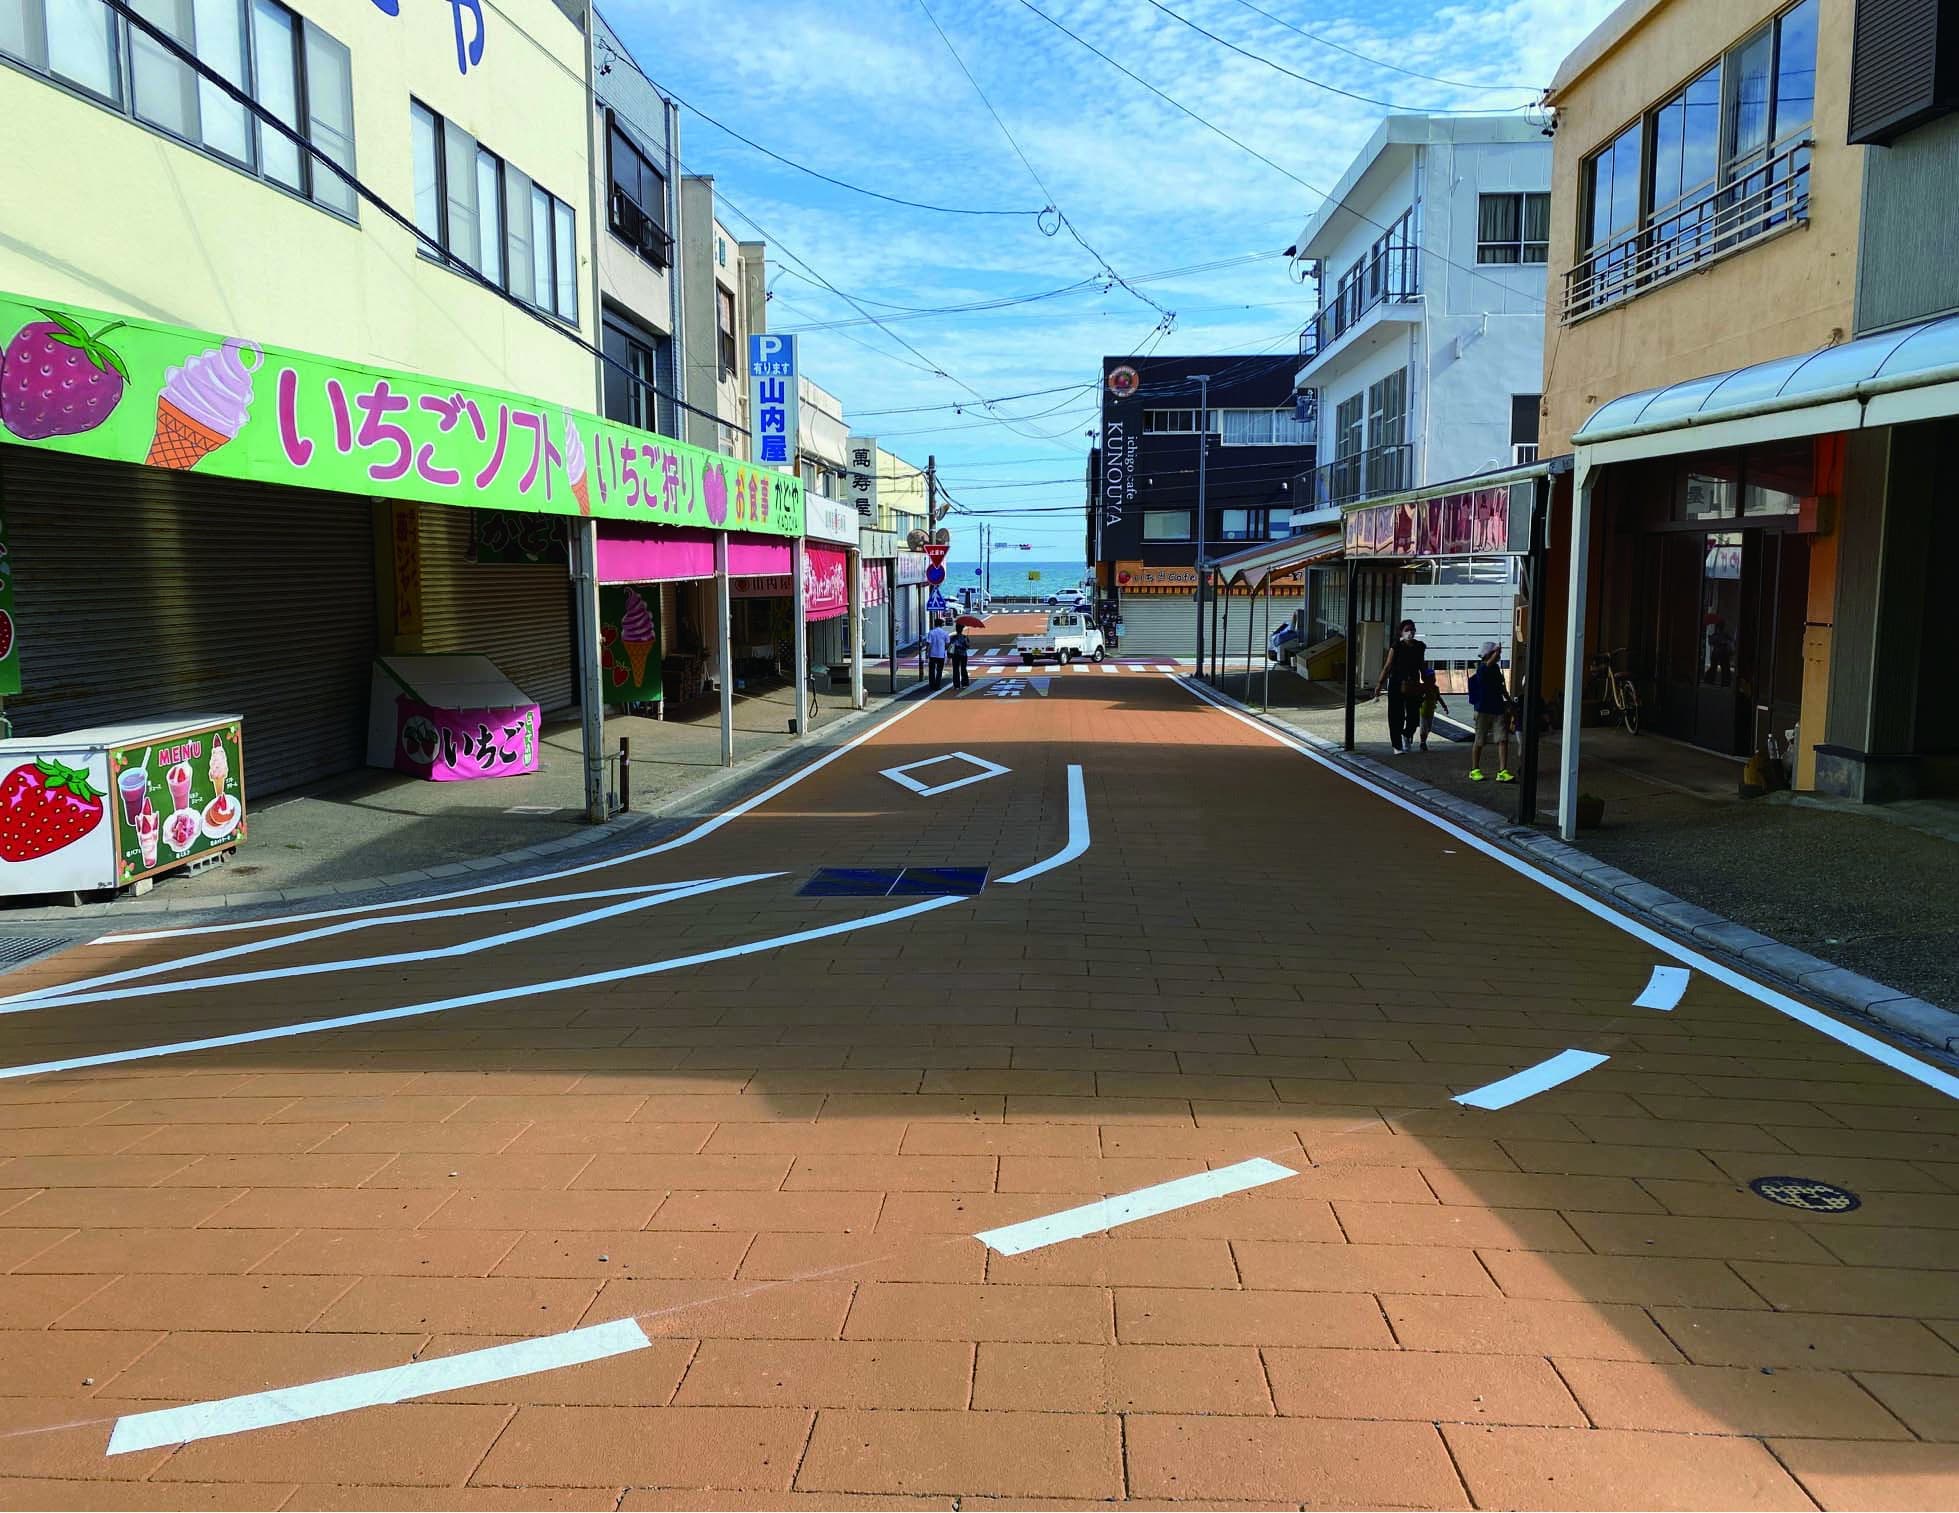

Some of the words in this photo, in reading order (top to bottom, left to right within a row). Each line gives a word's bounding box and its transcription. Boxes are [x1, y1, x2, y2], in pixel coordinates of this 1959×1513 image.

[753, 362, 790, 375] 有ります
[760, 336, 782, 361] P
[275, 367, 563, 501] いちごソフト
[760, 377, 787, 462] 山内屋
[594, 433, 694, 514] いちご狩り
[1106, 422, 1123, 528] KUNOUYA
[1125, 436, 1138, 473] ichigo
[734, 467, 770, 523] お食事
[775, 477, 799, 512] かどや
[158, 741, 202, 767] MENU
[442, 720, 525, 769] いちご
